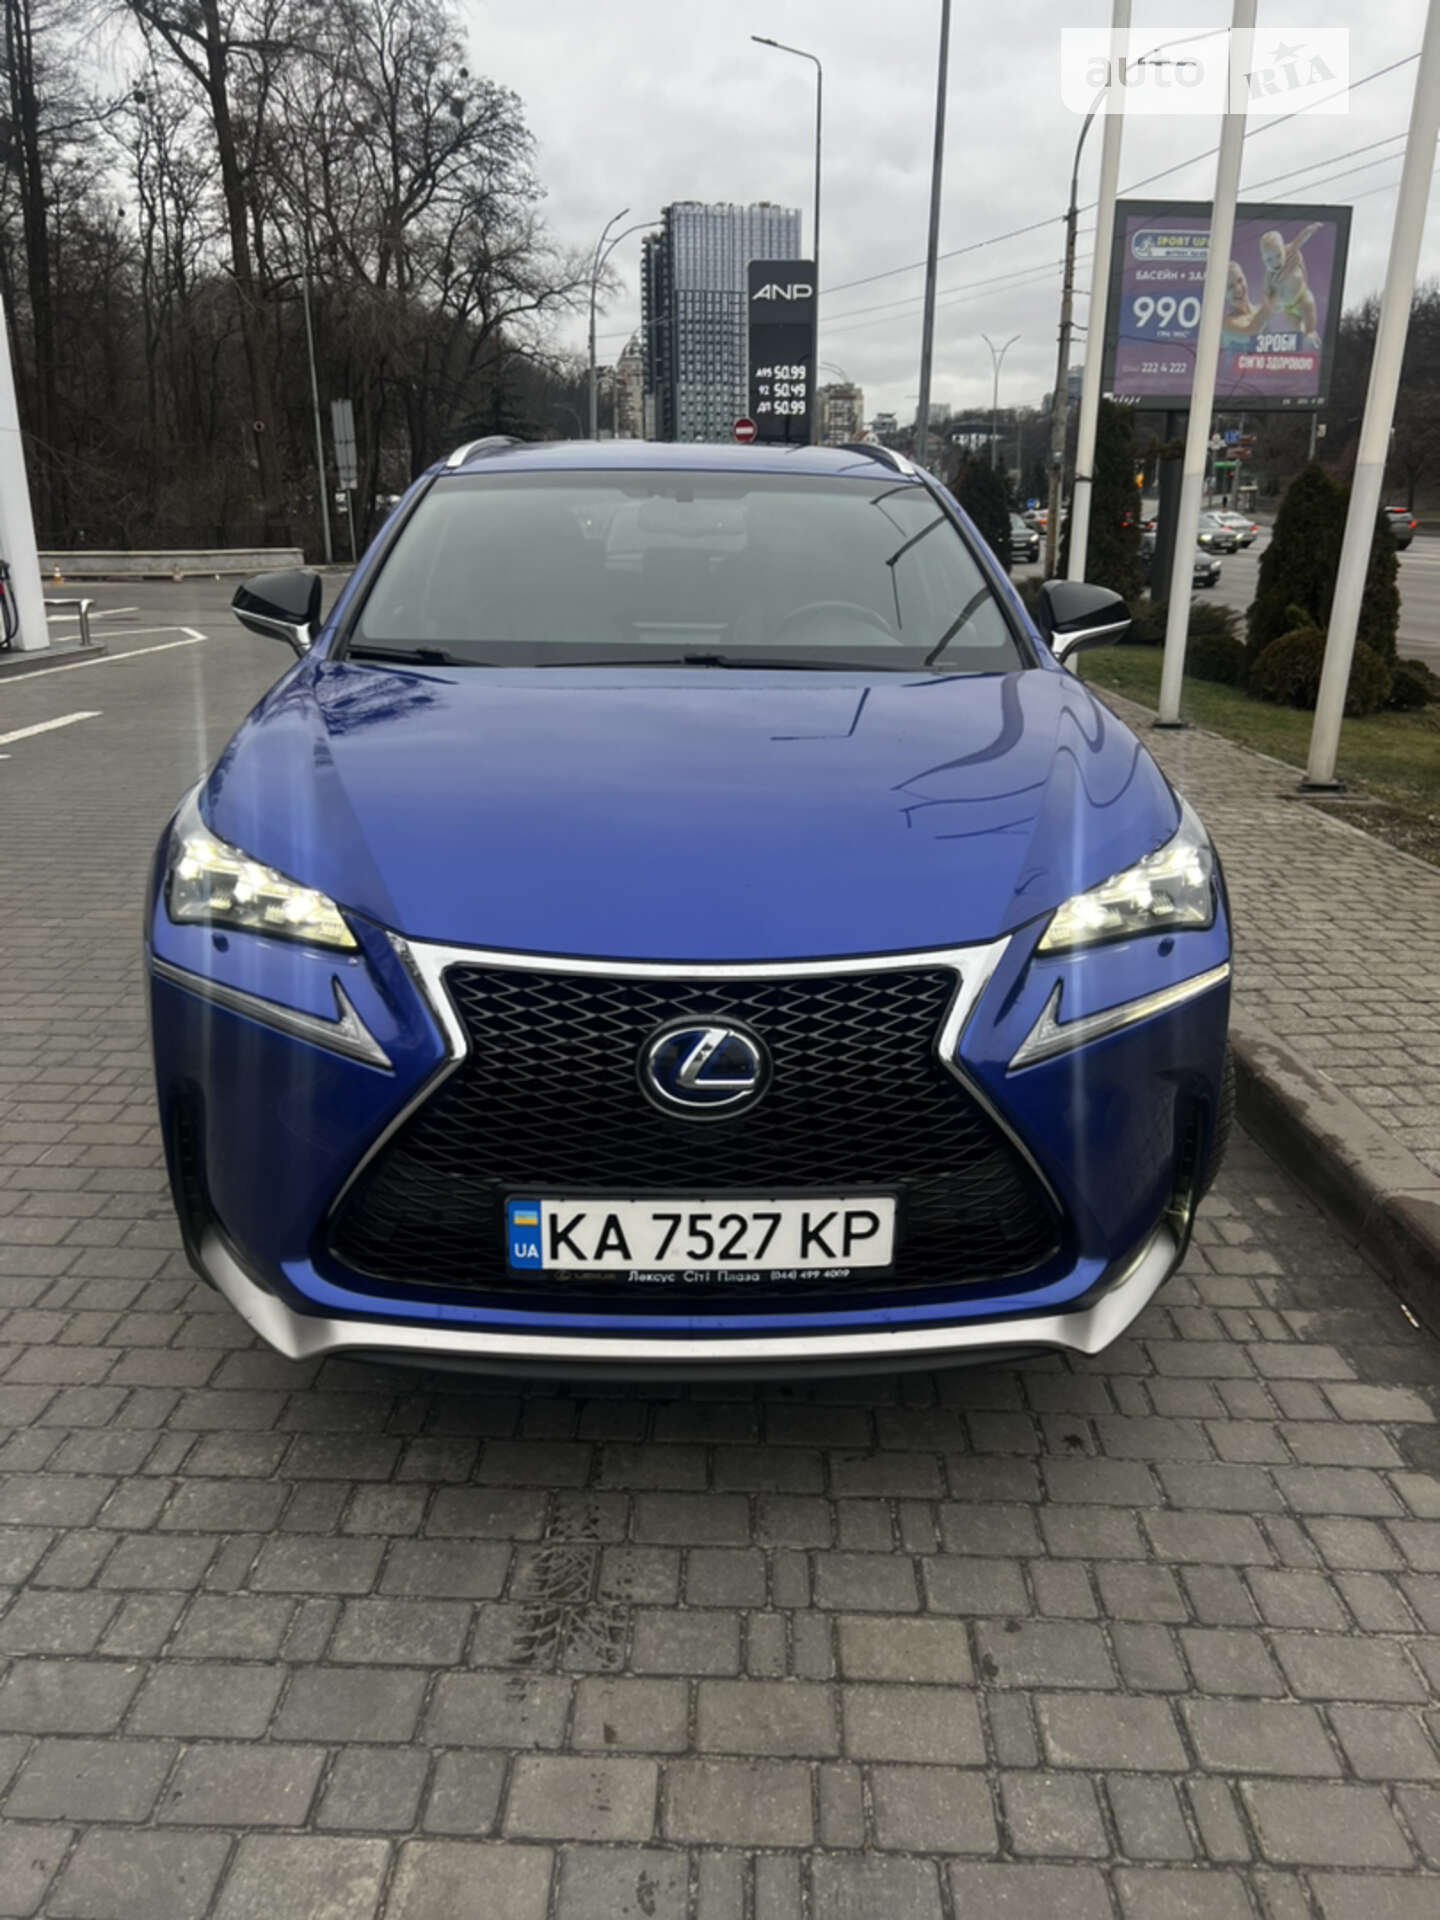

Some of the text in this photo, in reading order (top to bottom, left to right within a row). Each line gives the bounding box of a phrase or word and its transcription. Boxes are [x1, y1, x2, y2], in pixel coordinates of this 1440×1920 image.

[752, 284, 813, 300] ANP
[1133, 296, 1201, 328] 990
[1256, 333, 1296, 352] ЗРОБИ
[549, 1210, 880, 1260] KA 7527 KP
[514, 1243, 539, 1259] UA
[628, 1270, 675, 1283] Лексус
[717, 1270, 760, 1282] Плаза
